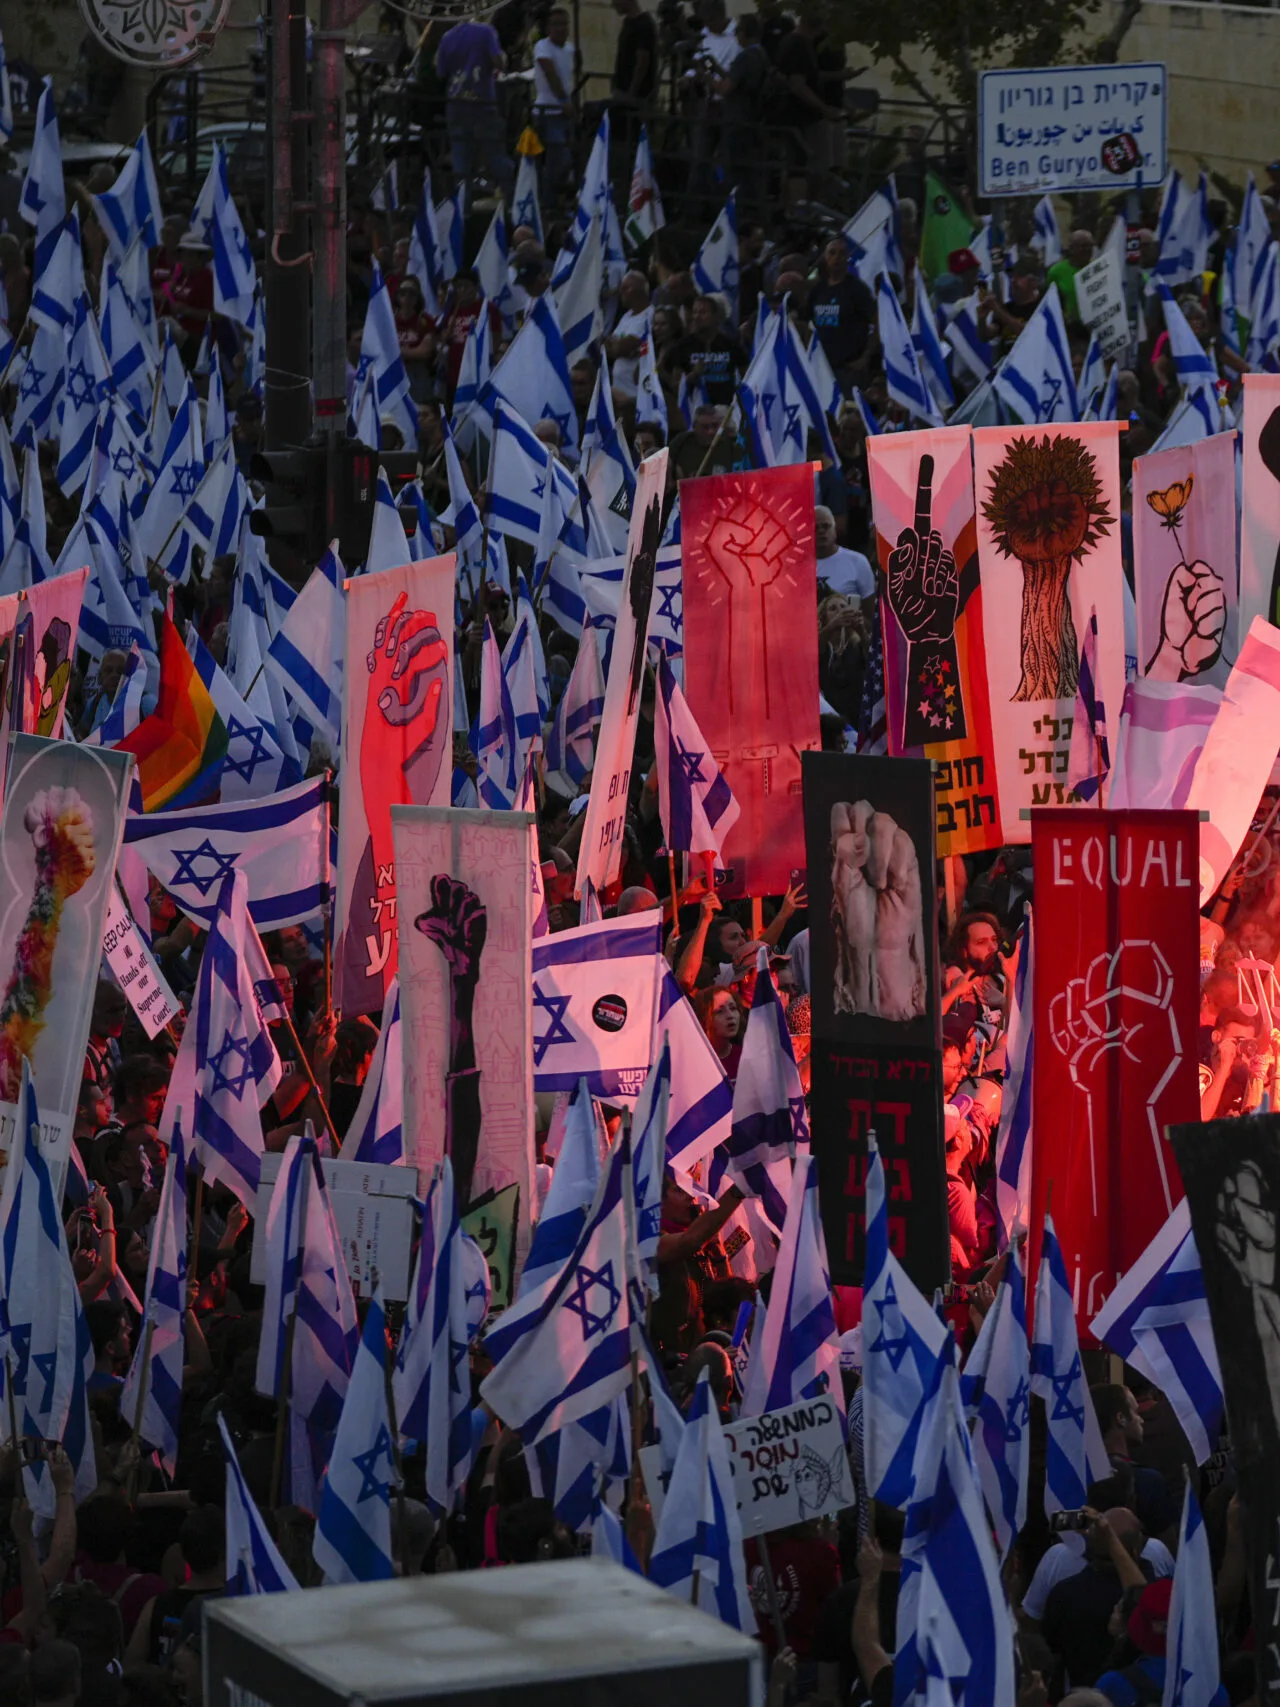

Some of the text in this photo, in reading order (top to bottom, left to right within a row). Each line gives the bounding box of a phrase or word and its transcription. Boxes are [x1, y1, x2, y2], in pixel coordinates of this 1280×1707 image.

[999, 81, 1149, 114] קרית בן גוריון
[991, 157, 1029, 178] Ben
[1038, 155, 1104, 177] Guryo
[935, 755, 985, 792] חופ
[1019, 748, 1069, 775] בדל
[937, 794, 996, 833] תרב
[1052, 836, 1192, 891] EQUAL
[119, 951, 149, 988] Hands off
[138, 974, 150, 989] our
[136, 985, 164, 1015] Supreme
[848, 1098, 912, 1145] דת
